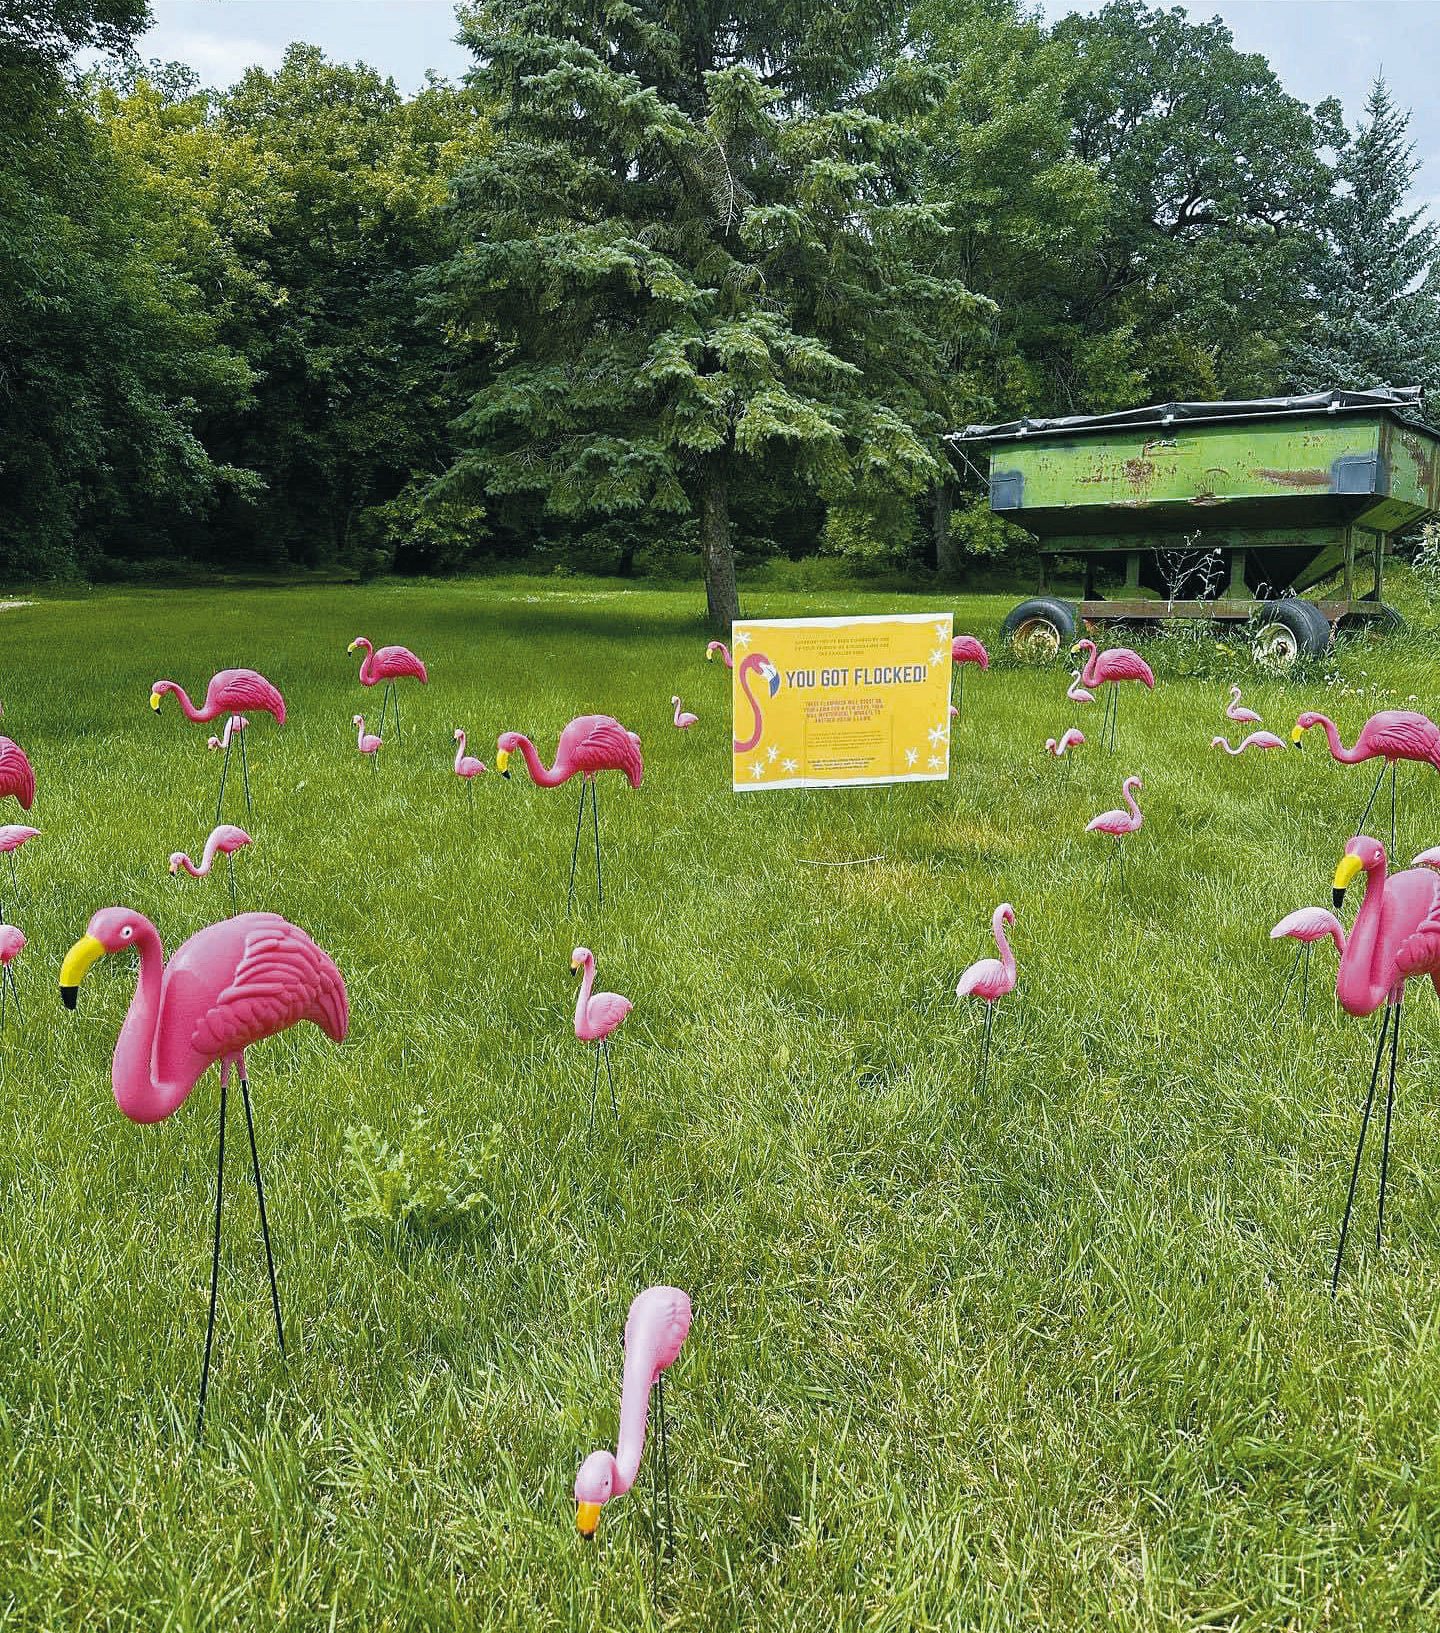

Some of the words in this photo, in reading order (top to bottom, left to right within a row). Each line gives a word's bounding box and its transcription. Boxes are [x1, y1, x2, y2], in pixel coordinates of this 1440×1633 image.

[786, 670, 816, 688] YOU
[821, 668, 849, 687] GOT
[854, 665, 927, 686] FLOCKED!
